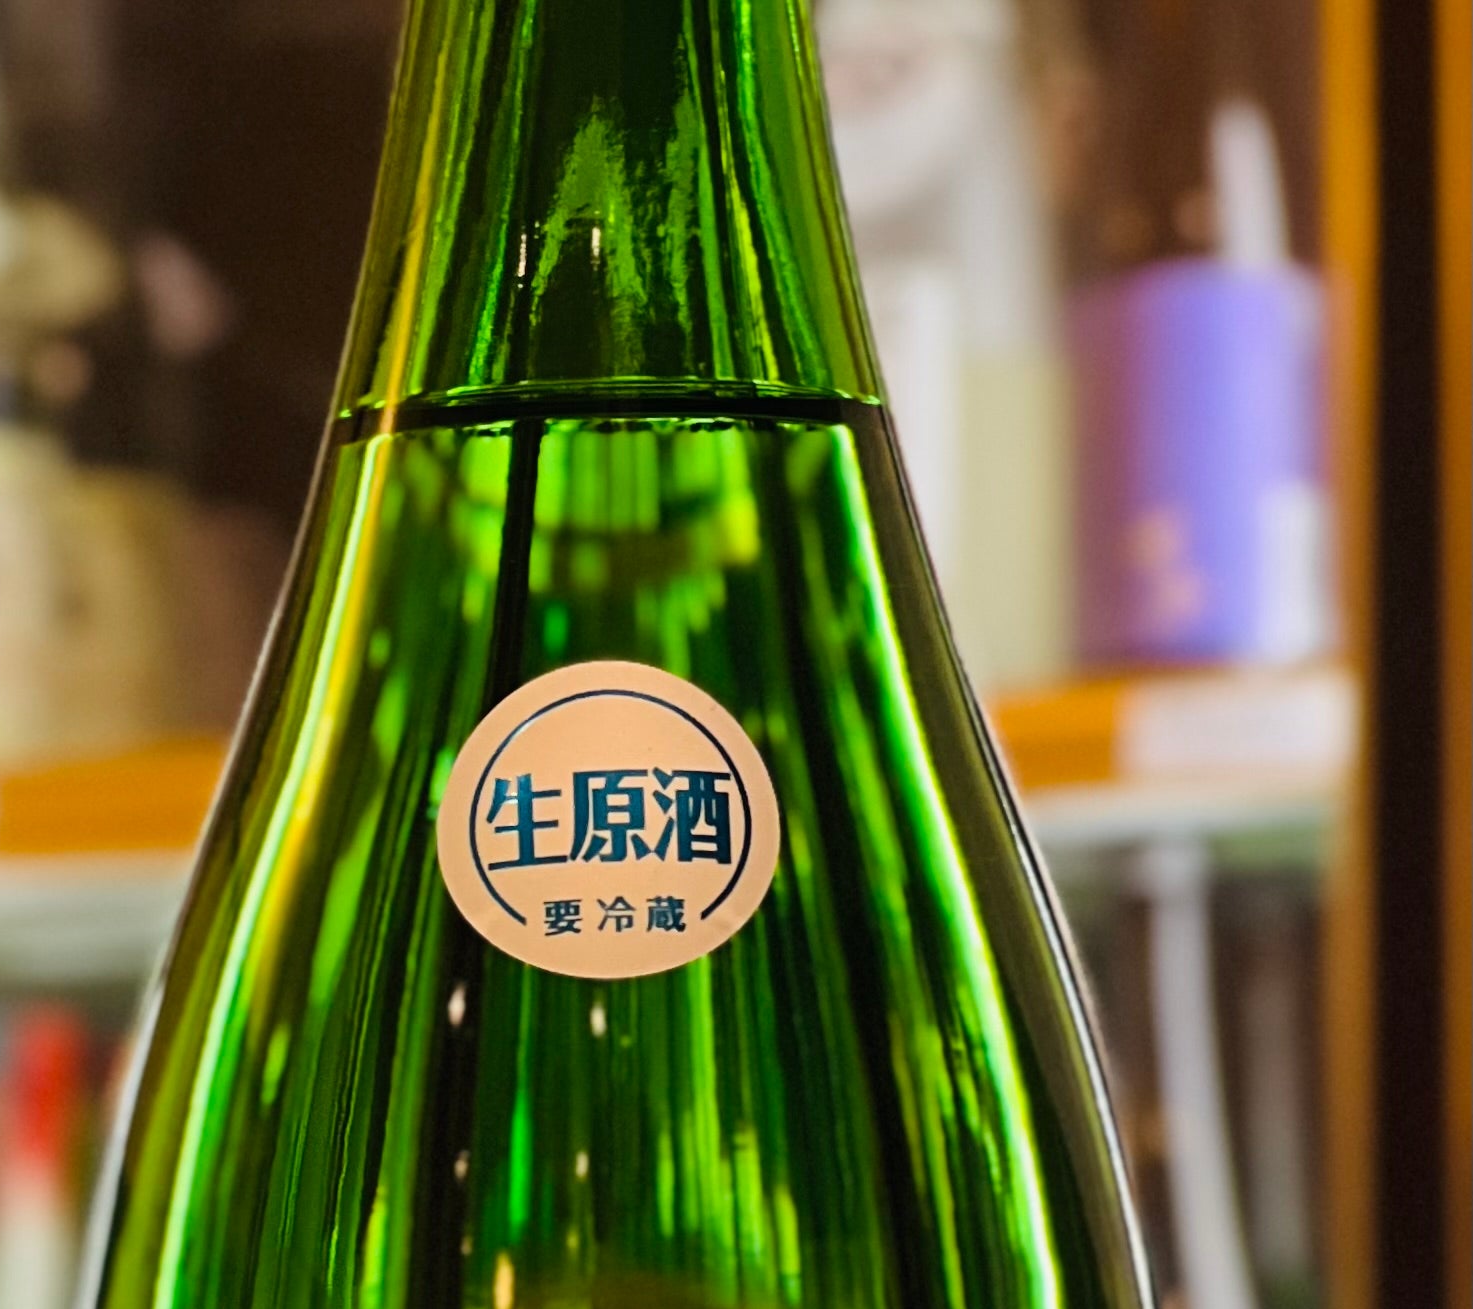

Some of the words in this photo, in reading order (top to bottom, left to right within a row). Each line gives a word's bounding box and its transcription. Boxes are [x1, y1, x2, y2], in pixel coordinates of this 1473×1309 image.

[485, 767, 732, 870] 生原酒
[543, 895, 687, 937] 要冷蔵
